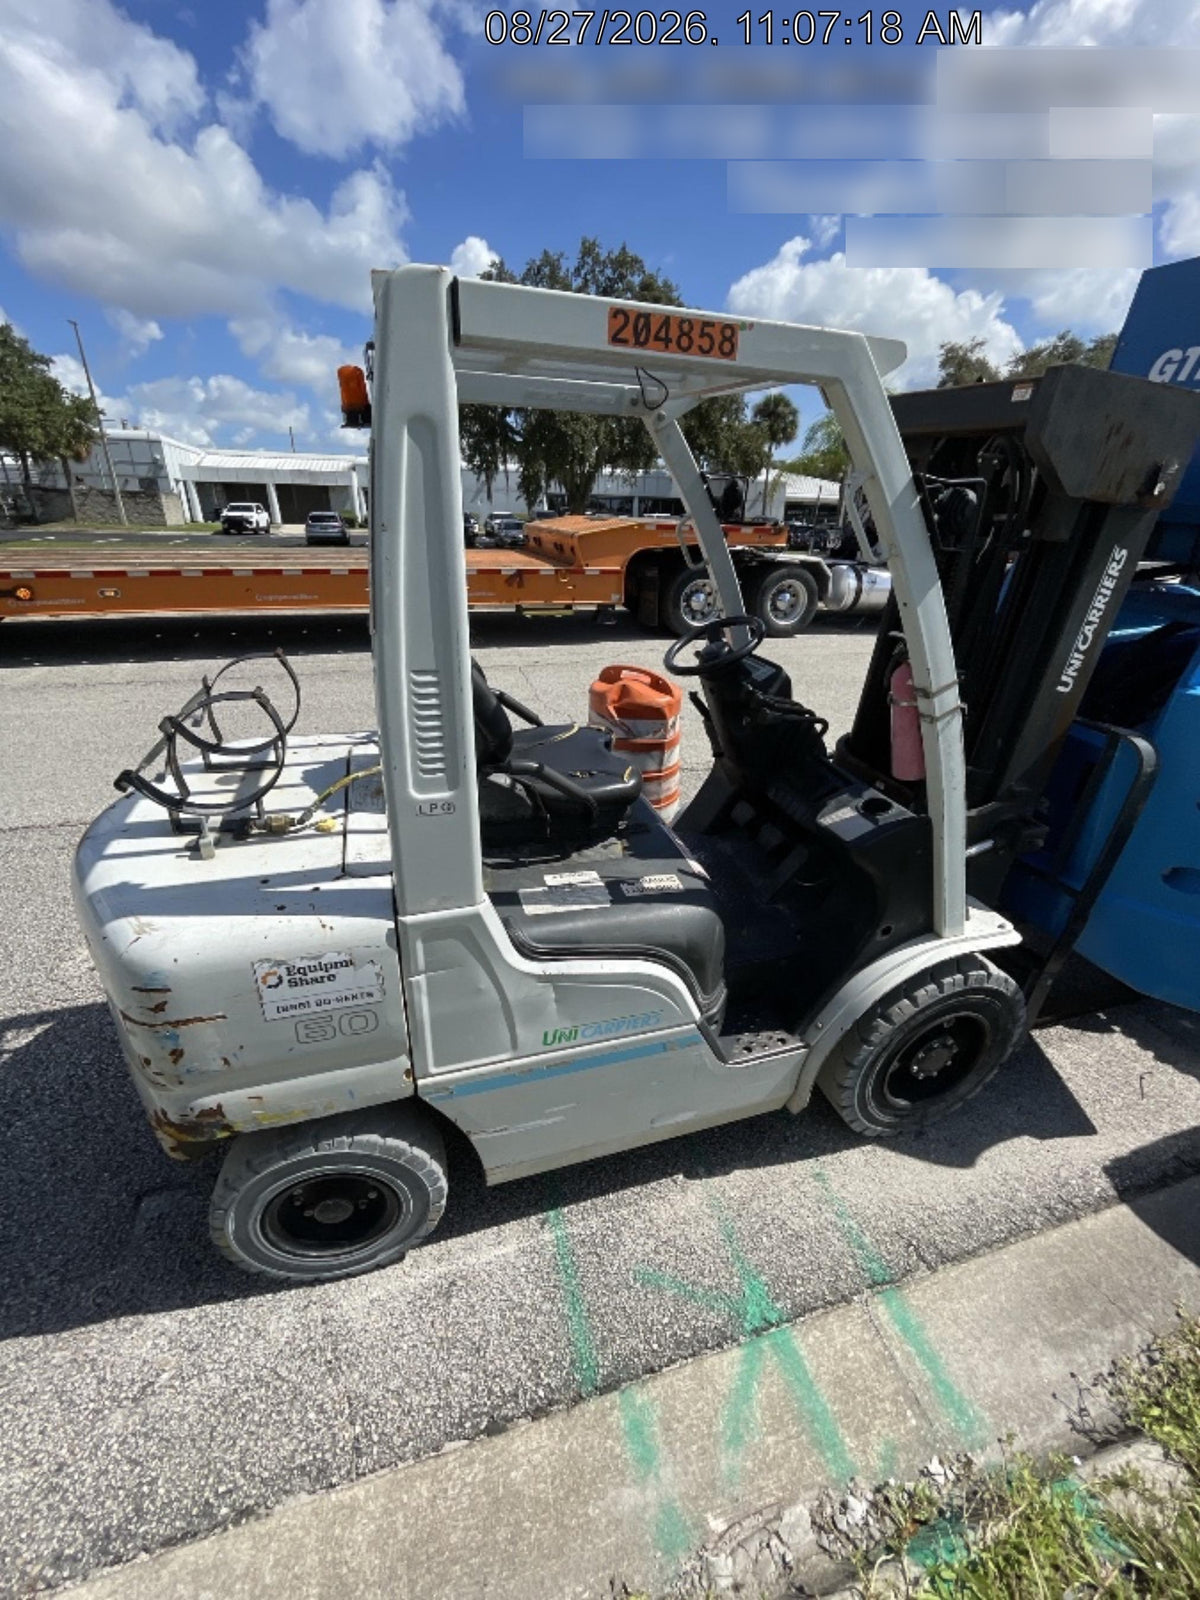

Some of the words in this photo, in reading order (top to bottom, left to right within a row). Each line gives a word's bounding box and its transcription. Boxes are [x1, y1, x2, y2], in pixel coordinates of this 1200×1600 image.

[611, 308, 736, 357] 204858
[1148, 346, 1200, 383] GT
[287, 972, 337, 988] Share
